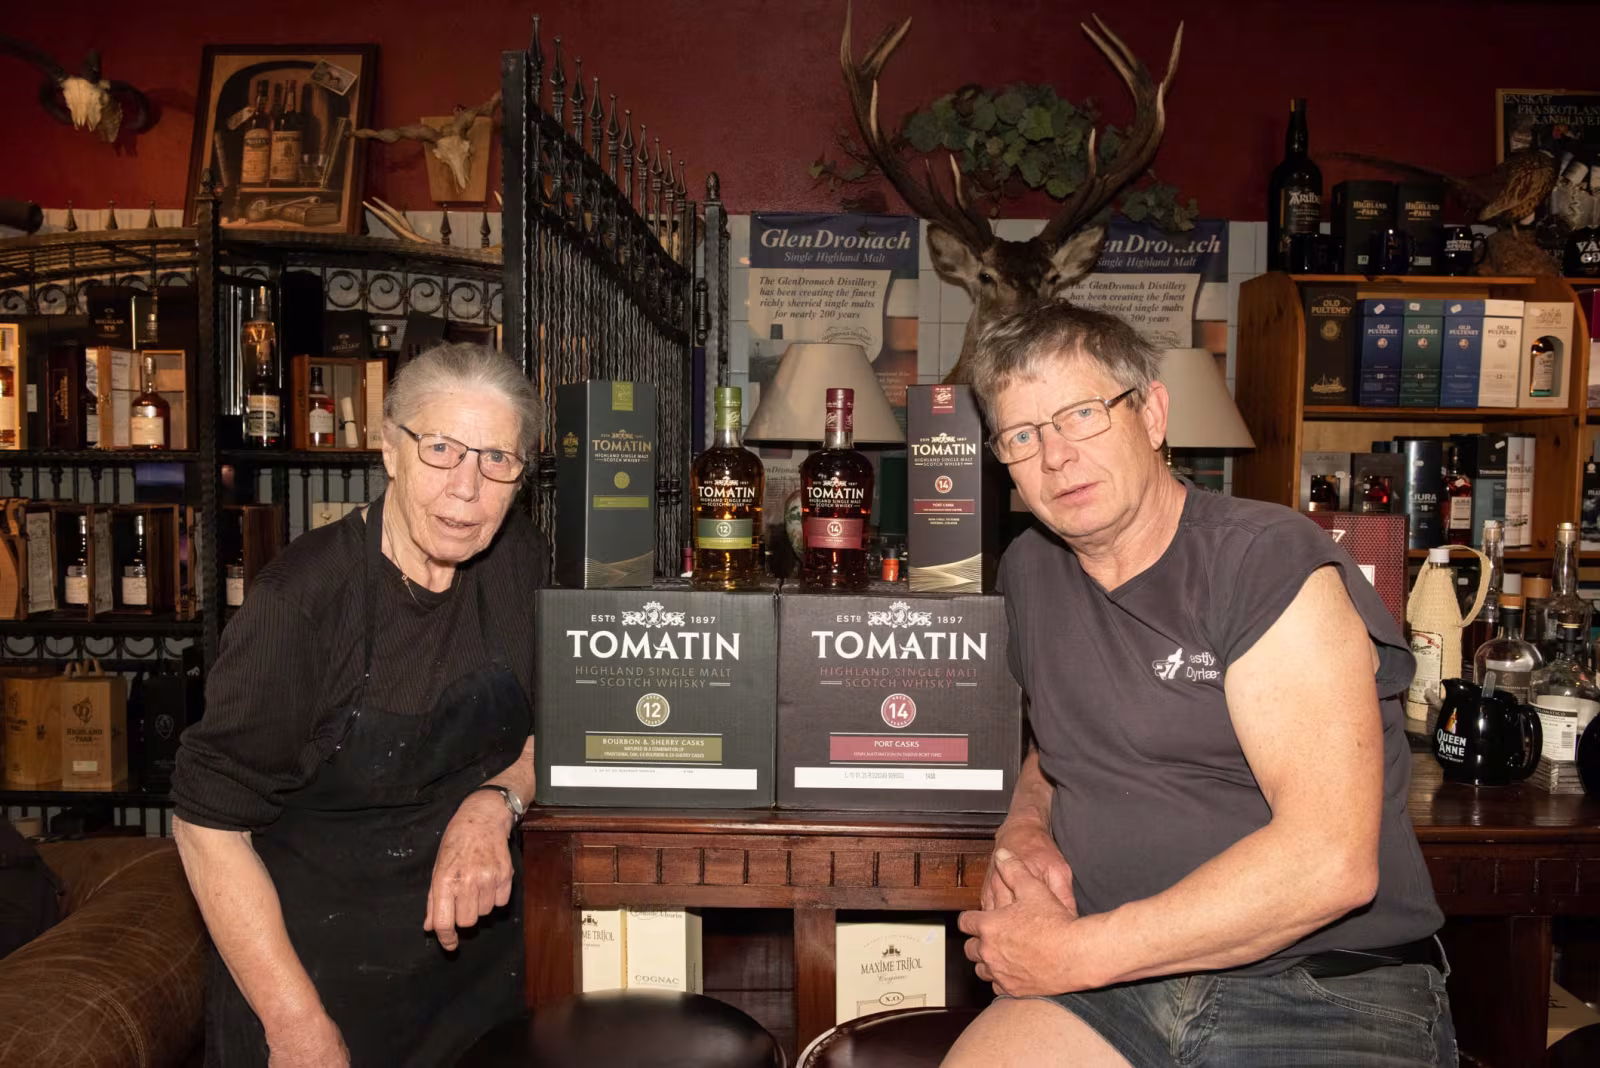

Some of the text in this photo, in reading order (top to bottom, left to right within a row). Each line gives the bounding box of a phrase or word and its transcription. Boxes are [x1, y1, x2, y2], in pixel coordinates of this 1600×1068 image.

[760, 228, 911, 250] GlenDronach
[1576, 241, 1600, 252] VA
[784, 251, 886, 264] Single Highland Malt
[1126, 257, 1170, 268] Highland
[1173, 257, 1197, 267] Malt
[760, 276, 878, 288] The GlenDronach Distillery
[1089, 281, 1145, 290] GlenDronach
[1148, 281, 1187, 292] Distillery
[760, 287, 876, 298] has been creating the finest
[1070, 292, 1186, 303] has been creating the finest
[760, 298, 875, 309] richly sherried single malts
[1134, 304, 1184, 313] single malts
[1323, 299, 1340, 307] OLD
[773, 310, 860, 321] for nearly 200 years
[1311, 306, 1352, 314] PULTENEY
[1148, 315, 1170, 323] years
[592, 440, 652, 452] TOMATIN
[911, 443, 976, 456] TOMATIN
[939, 480, 949, 489] 14
[697, 486, 755, 498] TOMATIN
[807, 487, 864, 499] TOMATIN
[1412, 493, 1437, 501] JURA
[719, 525, 728, 533] 12
[830, 525, 839, 533] 14
[690, 616, 716, 624] 1897
[937, 616, 963, 624] 1897
[566, 630, 740, 661] TOMATIN
[811, 630, 987, 661] TOMATIN
[575, 665, 731, 678] HIGHLAND SINGLE MALT
[820, 666, 977, 678] HIGHLAND SINGLE MALT
[600, 677, 706, 688] SCOTCH WHISKY
[845, 678, 953, 689] SCOTCH WHISKY
[643, 702, 661, 718] 12
[888, 702, 909, 720] 14
[67, 728, 102, 736] HIGHLAND
[1437, 728, 1467, 747] QUEEN
[1439, 743, 1465, 757] ANNE
[635, 974, 679, 985] COGNAC
